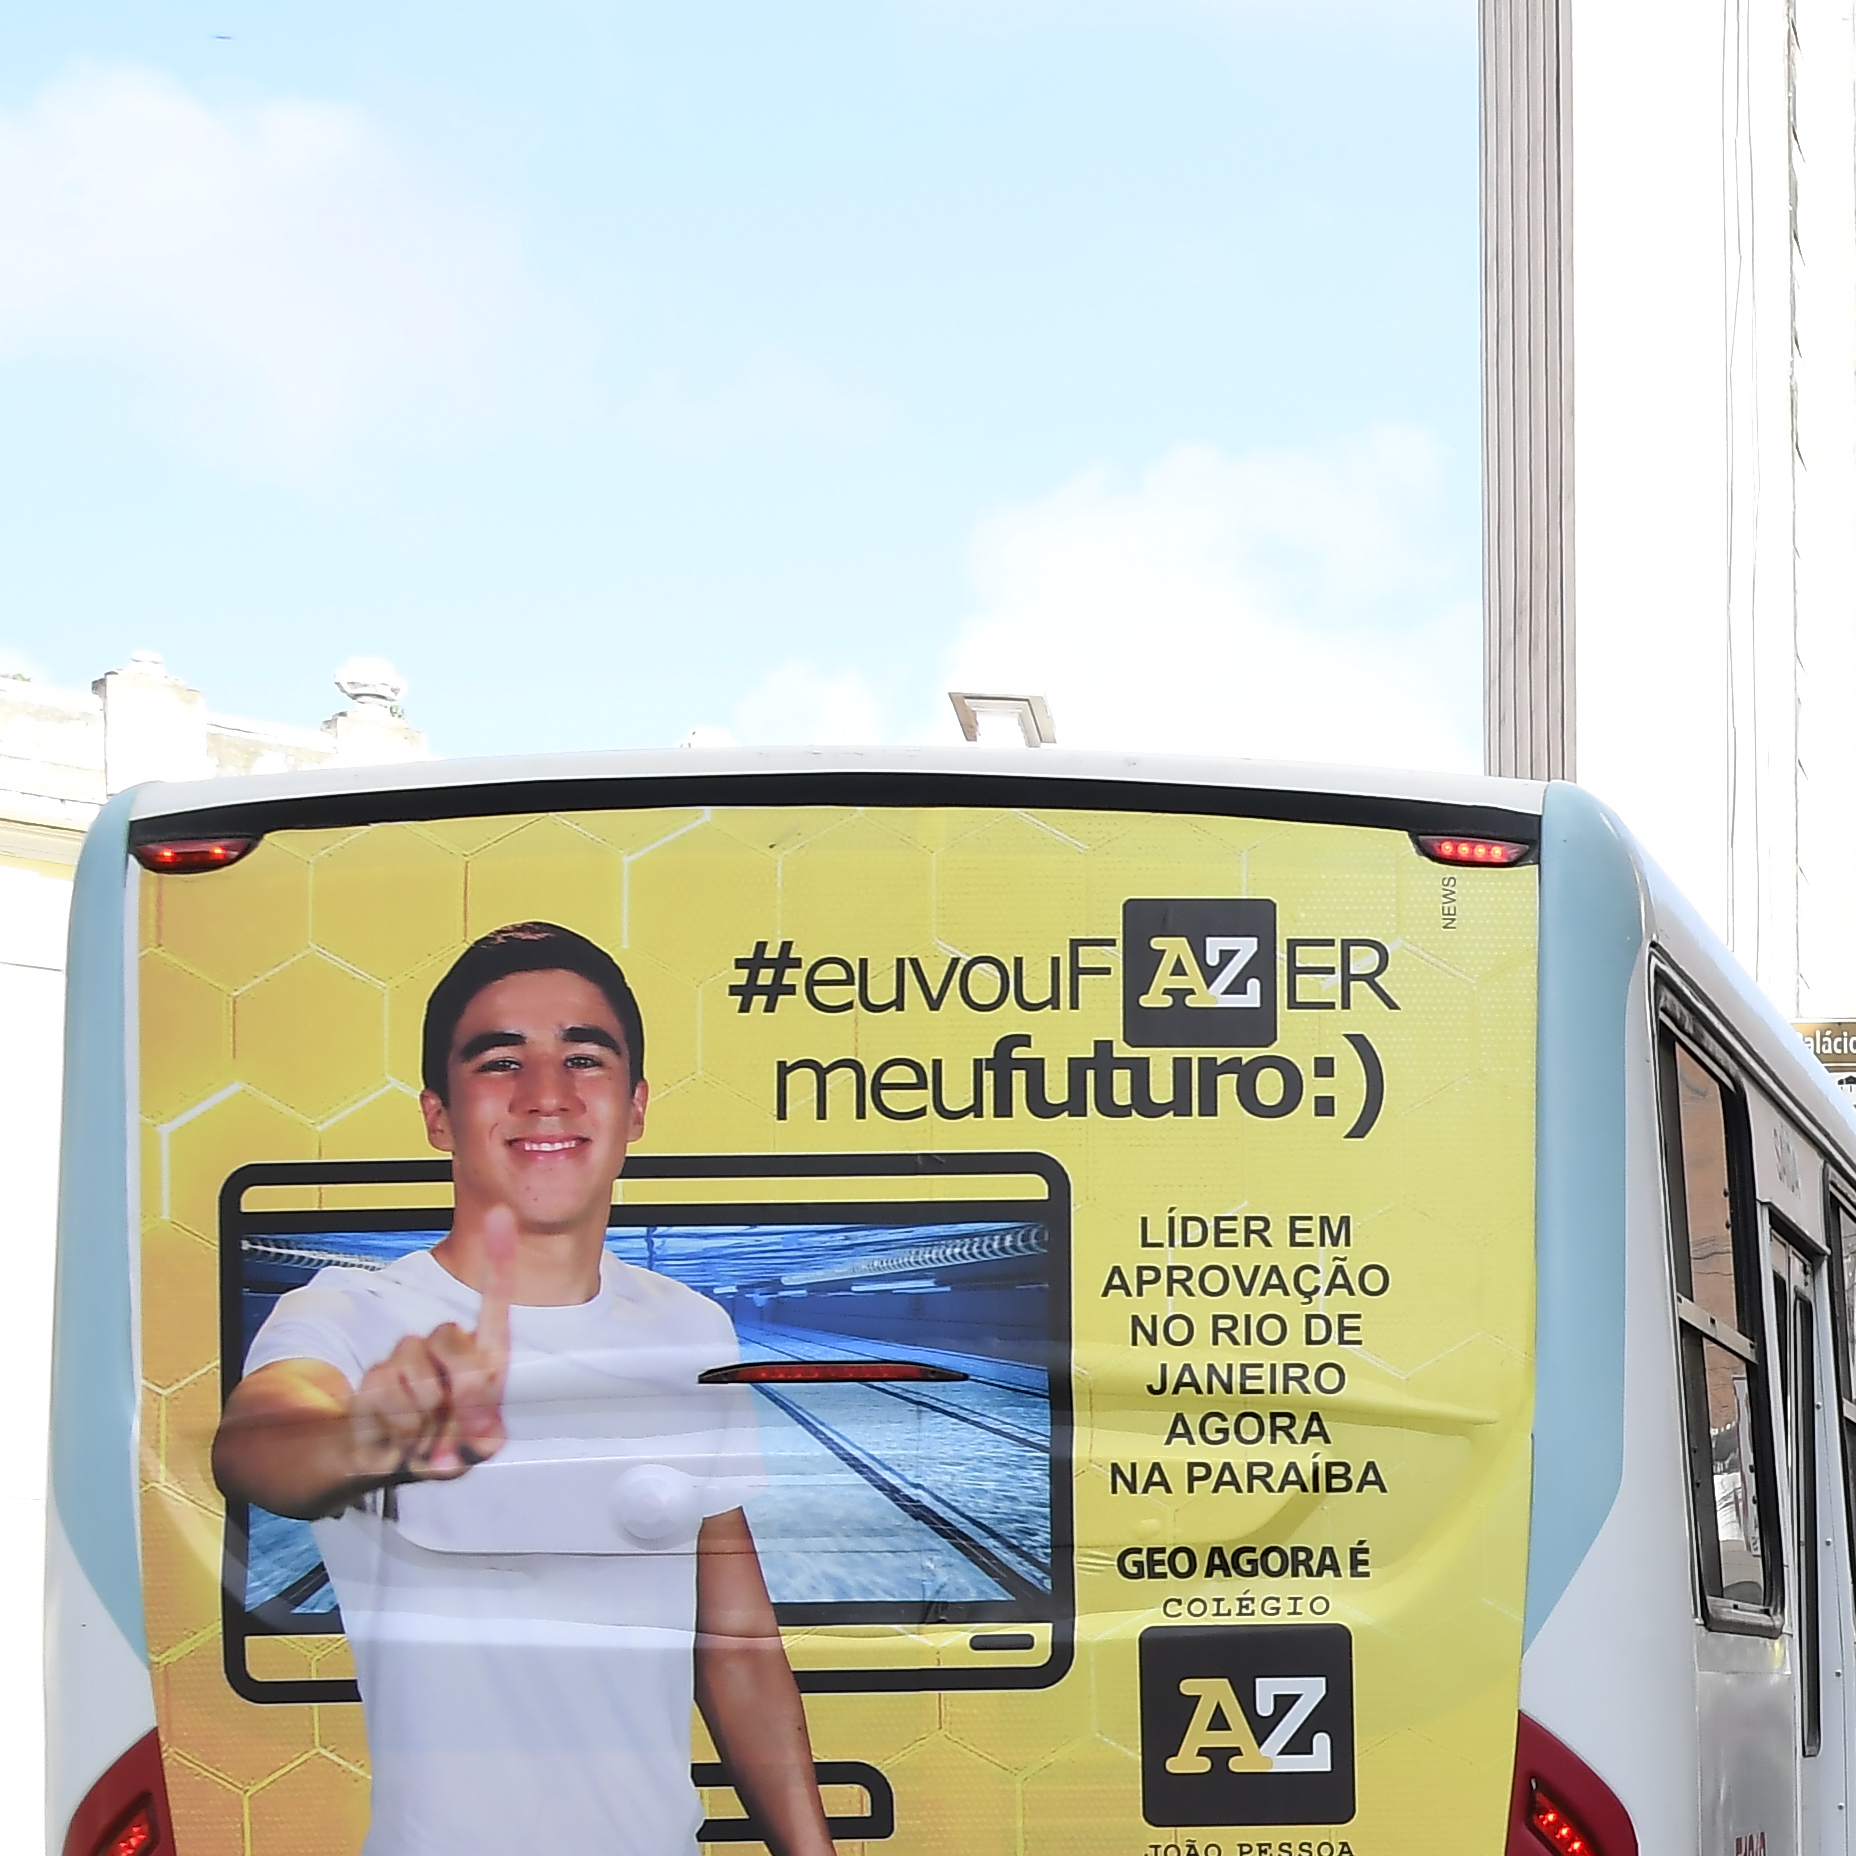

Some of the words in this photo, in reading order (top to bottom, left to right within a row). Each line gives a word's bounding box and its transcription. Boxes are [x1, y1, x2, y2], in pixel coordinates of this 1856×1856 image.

[1441, 876, 1457, 930] NEWS
[1140, 1206, 1273, 1248] LÍDER
[1288, 1215, 1352, 1248] EM
[1100, 1255, 1391, 1306] APROVAÇÃO
[1131, 1314, 1195, 1347] NO
[1211, 1313, 1288, 1347] RIO
[1304, 1313, 1363, 1346] DE
[1145, 1362, 1347, 1396] JANEIRO
[1164, 1411, 1332, 1446] AGORA
[1110, 1461, 1174, 1495] NA
[1186, 1451, 1389, 1495] PARAÍBA
[1116, 1546, 1197, 1580] GEO
[1204, 1545, 1342, 1579] AGORA
[1349, 1539, 1371, 1578] É
[1162, 1589, 1331, 1618] COLÉGIO
[1164, 1675, 1333, 1775] AZ
